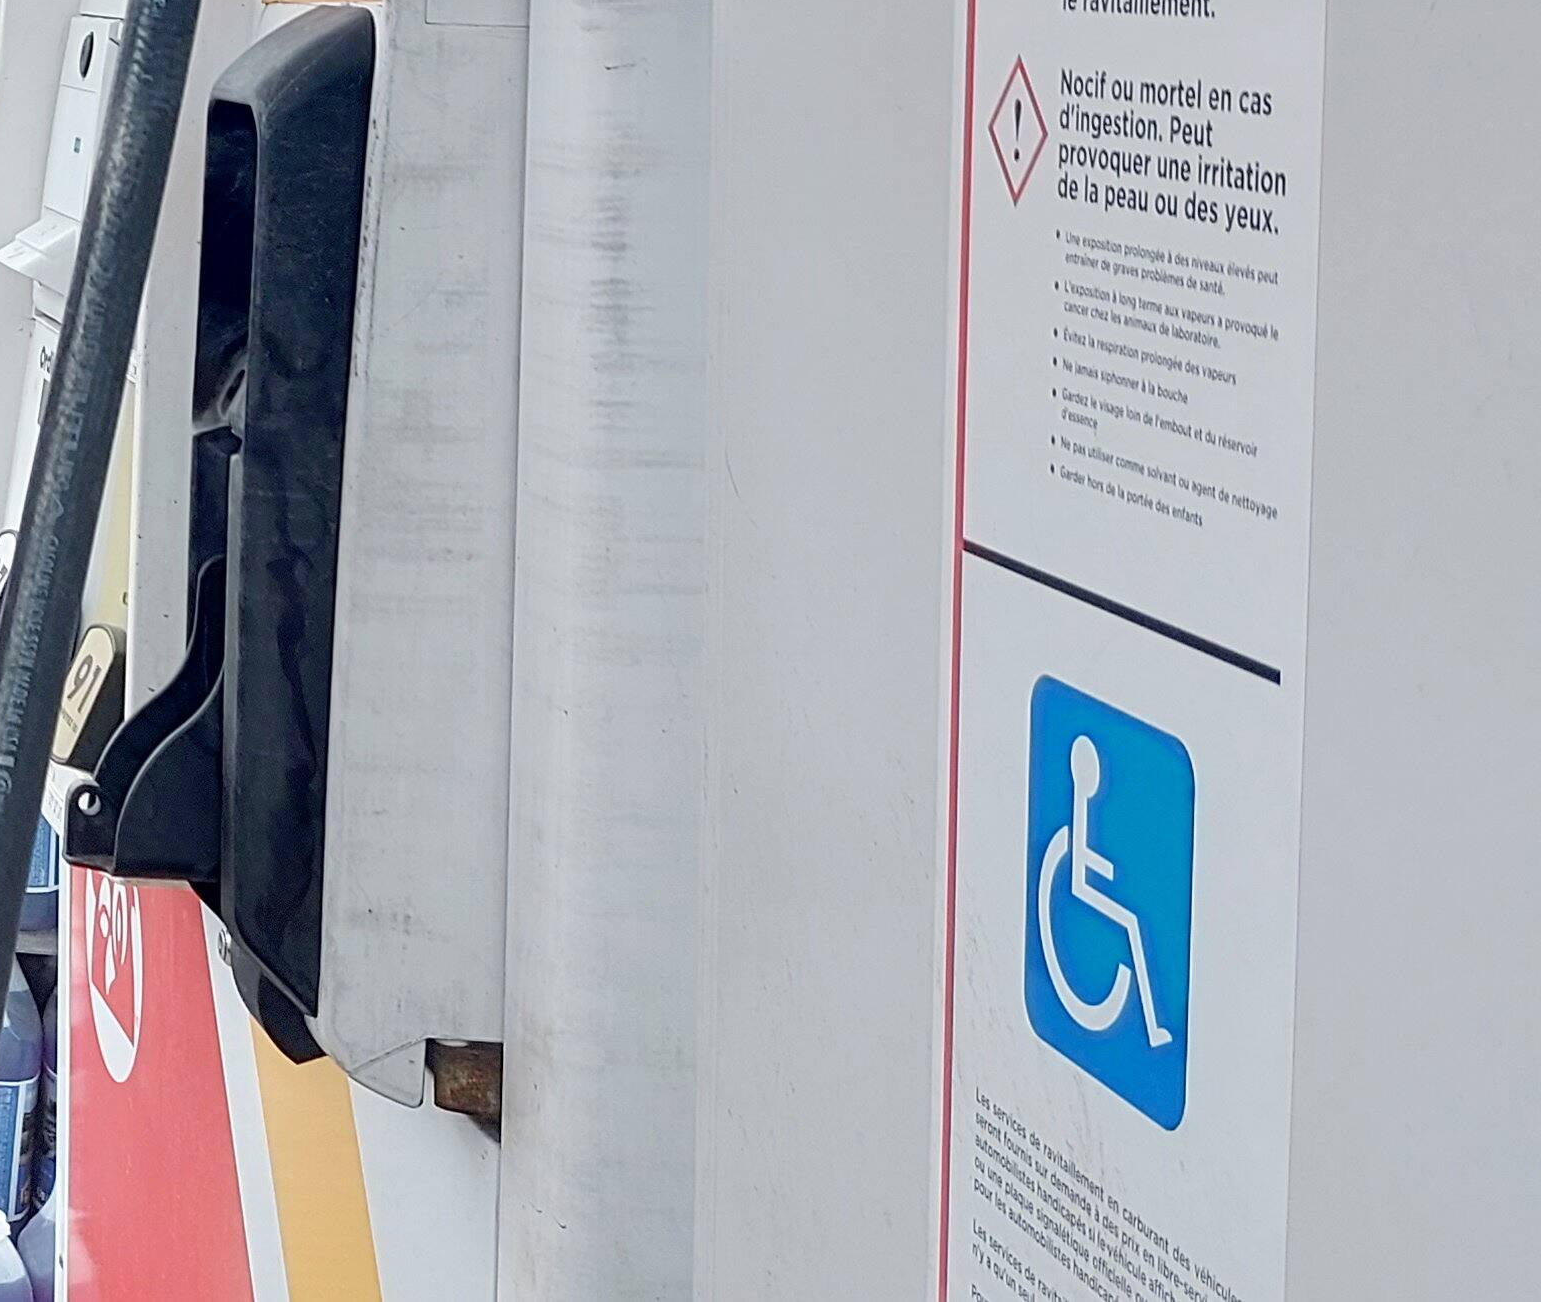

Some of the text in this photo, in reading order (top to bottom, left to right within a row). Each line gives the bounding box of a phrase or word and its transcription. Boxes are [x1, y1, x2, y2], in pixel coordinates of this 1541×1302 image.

[1060, 68, 1272, 116] Nocif ou mortel en cas
[1059, 102, 1213, 148] d'ingestion. Peut
[1058, 143, 1286, 197] provoquer une irritation
[1057, 171, 1279, 235] de la peau ou des yeux.
[67, 653, 102, 714] 91
[975, 1086, 991, 1111] Les
[992, 1103, 1027, 1140] services
[1029, 1131, 1041, 1152] de
[1043, 1143, 1105, 1203] ravitaillement
[1107, 1195, 1120, 1215] en
[1122, 1207, 1169, 1256] carburant
[1172, 1245, 1191, 1272] des
[975, 1112, 1002, 1144] seront
[1003, 1130, 1033, 1168] fournis
[1034, 1160, 1049, 1180] sur
[1050, 1171, 1092, 1217] demande
[1094, 1204, 1100, 1224] à
[1101, 1215, 1119, 1239] des
[1121, 1231, 1140, 1257] prix
[1142, 1248, 1155, 1268] en
[974, 1156, 1133, 1299] ou une plaque signalétique officielle
